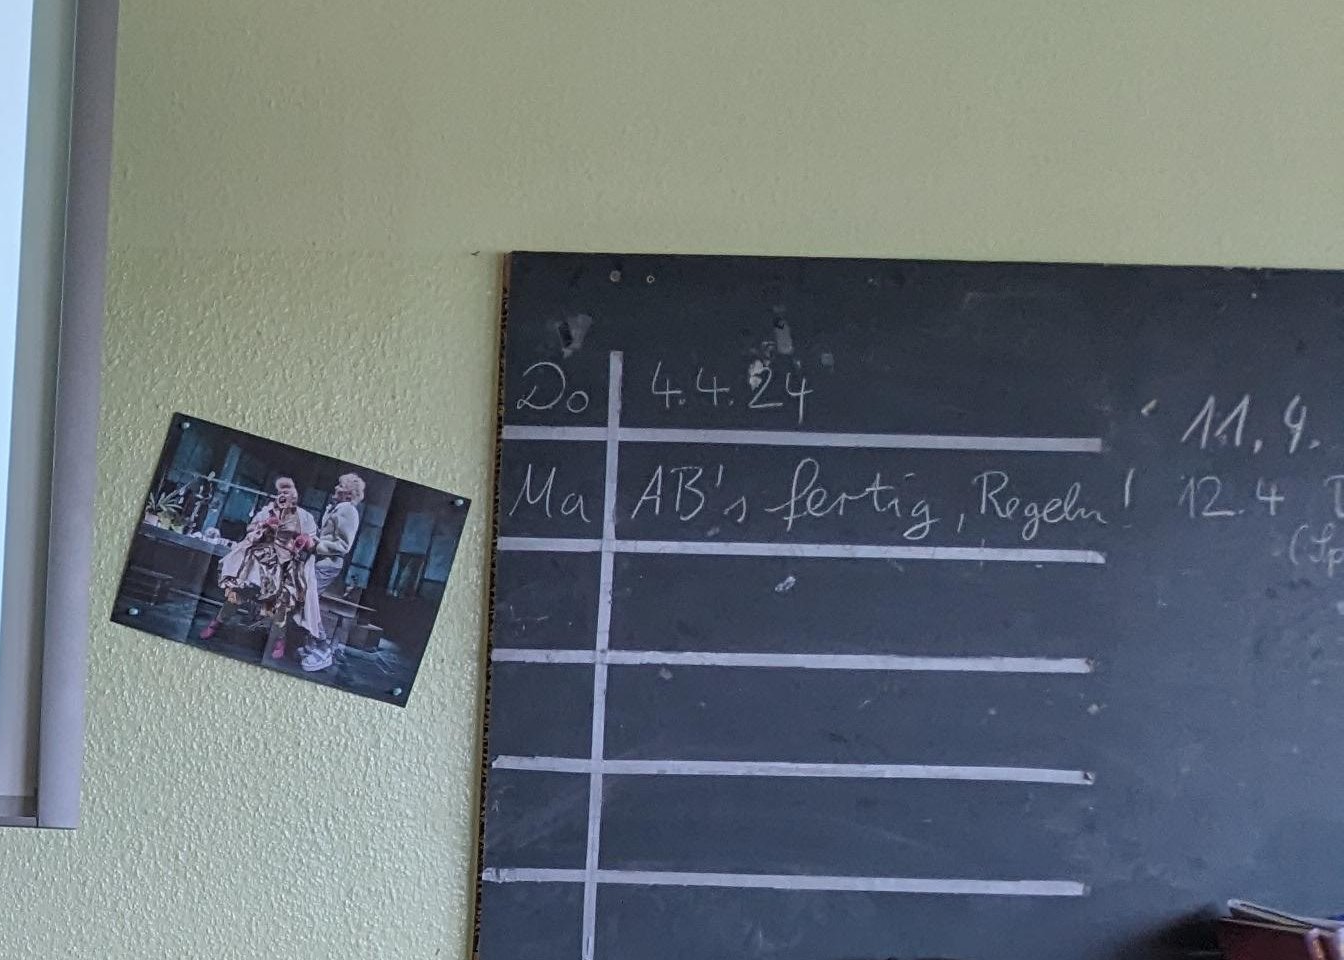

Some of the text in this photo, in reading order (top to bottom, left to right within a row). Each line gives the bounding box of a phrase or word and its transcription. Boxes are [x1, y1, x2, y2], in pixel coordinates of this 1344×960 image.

[517, 363, 814, 424] Do 4.4.24
[509, 472, 591, 522] Ma
